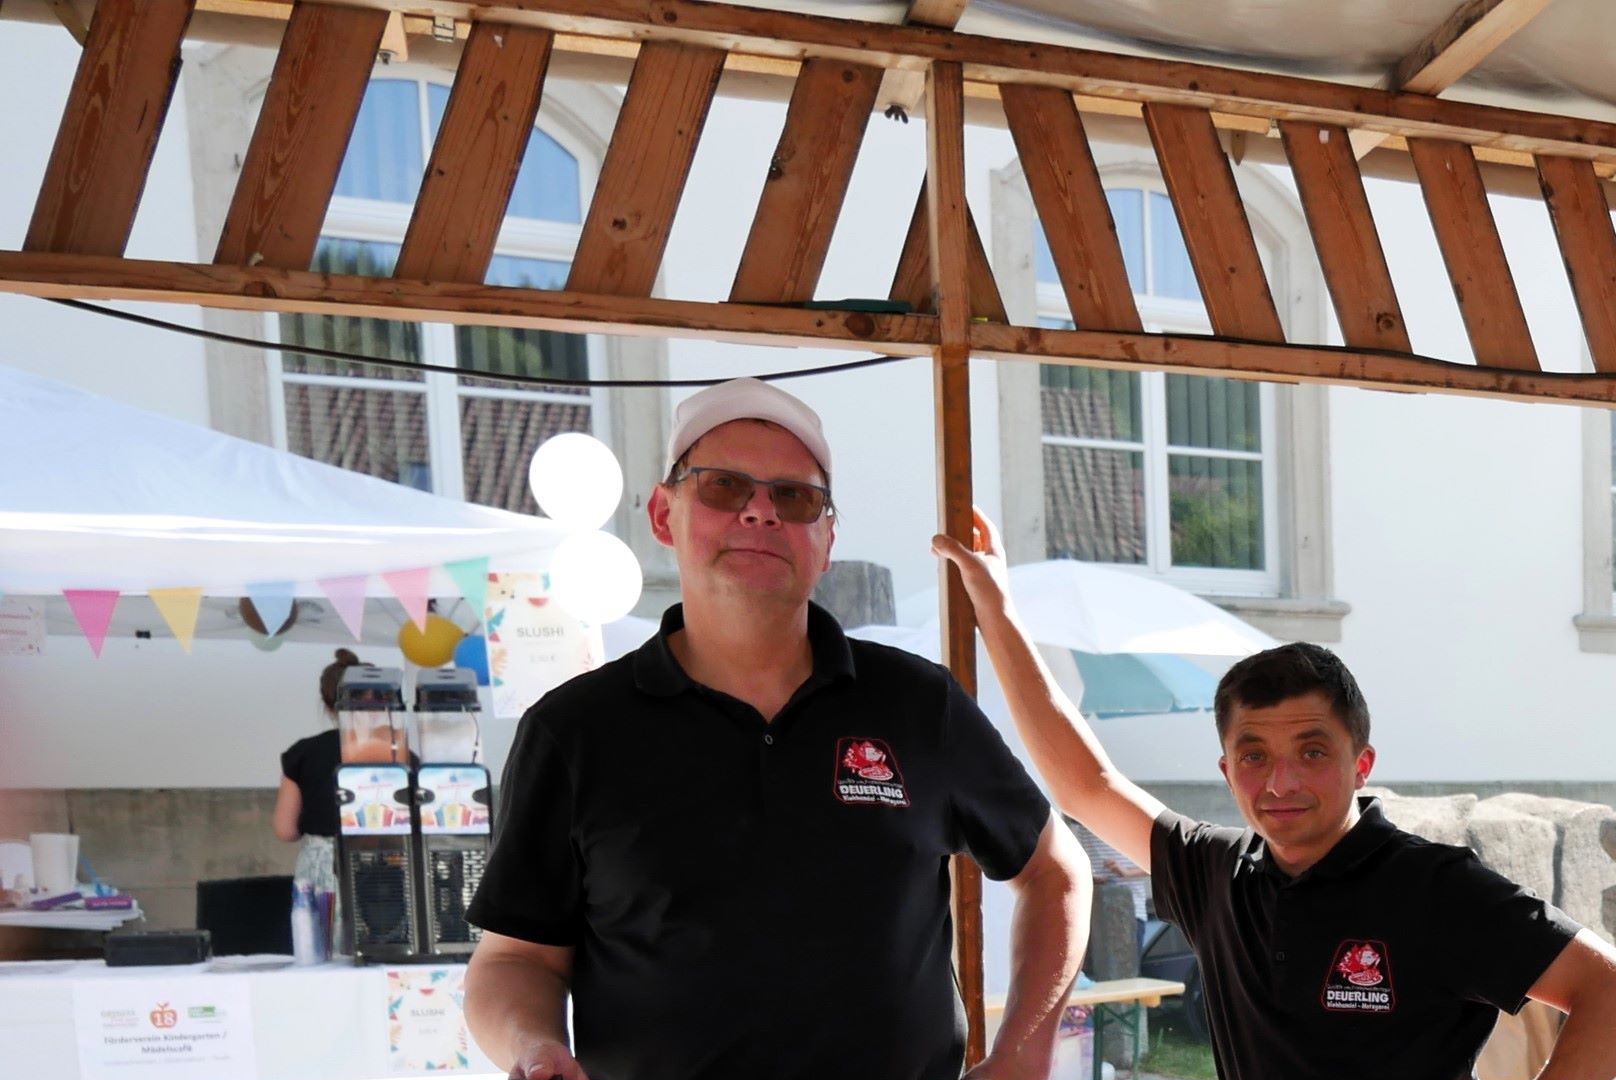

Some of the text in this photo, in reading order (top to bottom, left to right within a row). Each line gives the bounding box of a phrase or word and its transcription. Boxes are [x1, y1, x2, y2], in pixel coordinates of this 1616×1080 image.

[516, 625, 564, 638] SLUSHI
[839, 784, 904, 799] DEUERLING
[1327, 990, 1389, 1003] DEUERLING
[155, 1012, 176, 1026] 18
